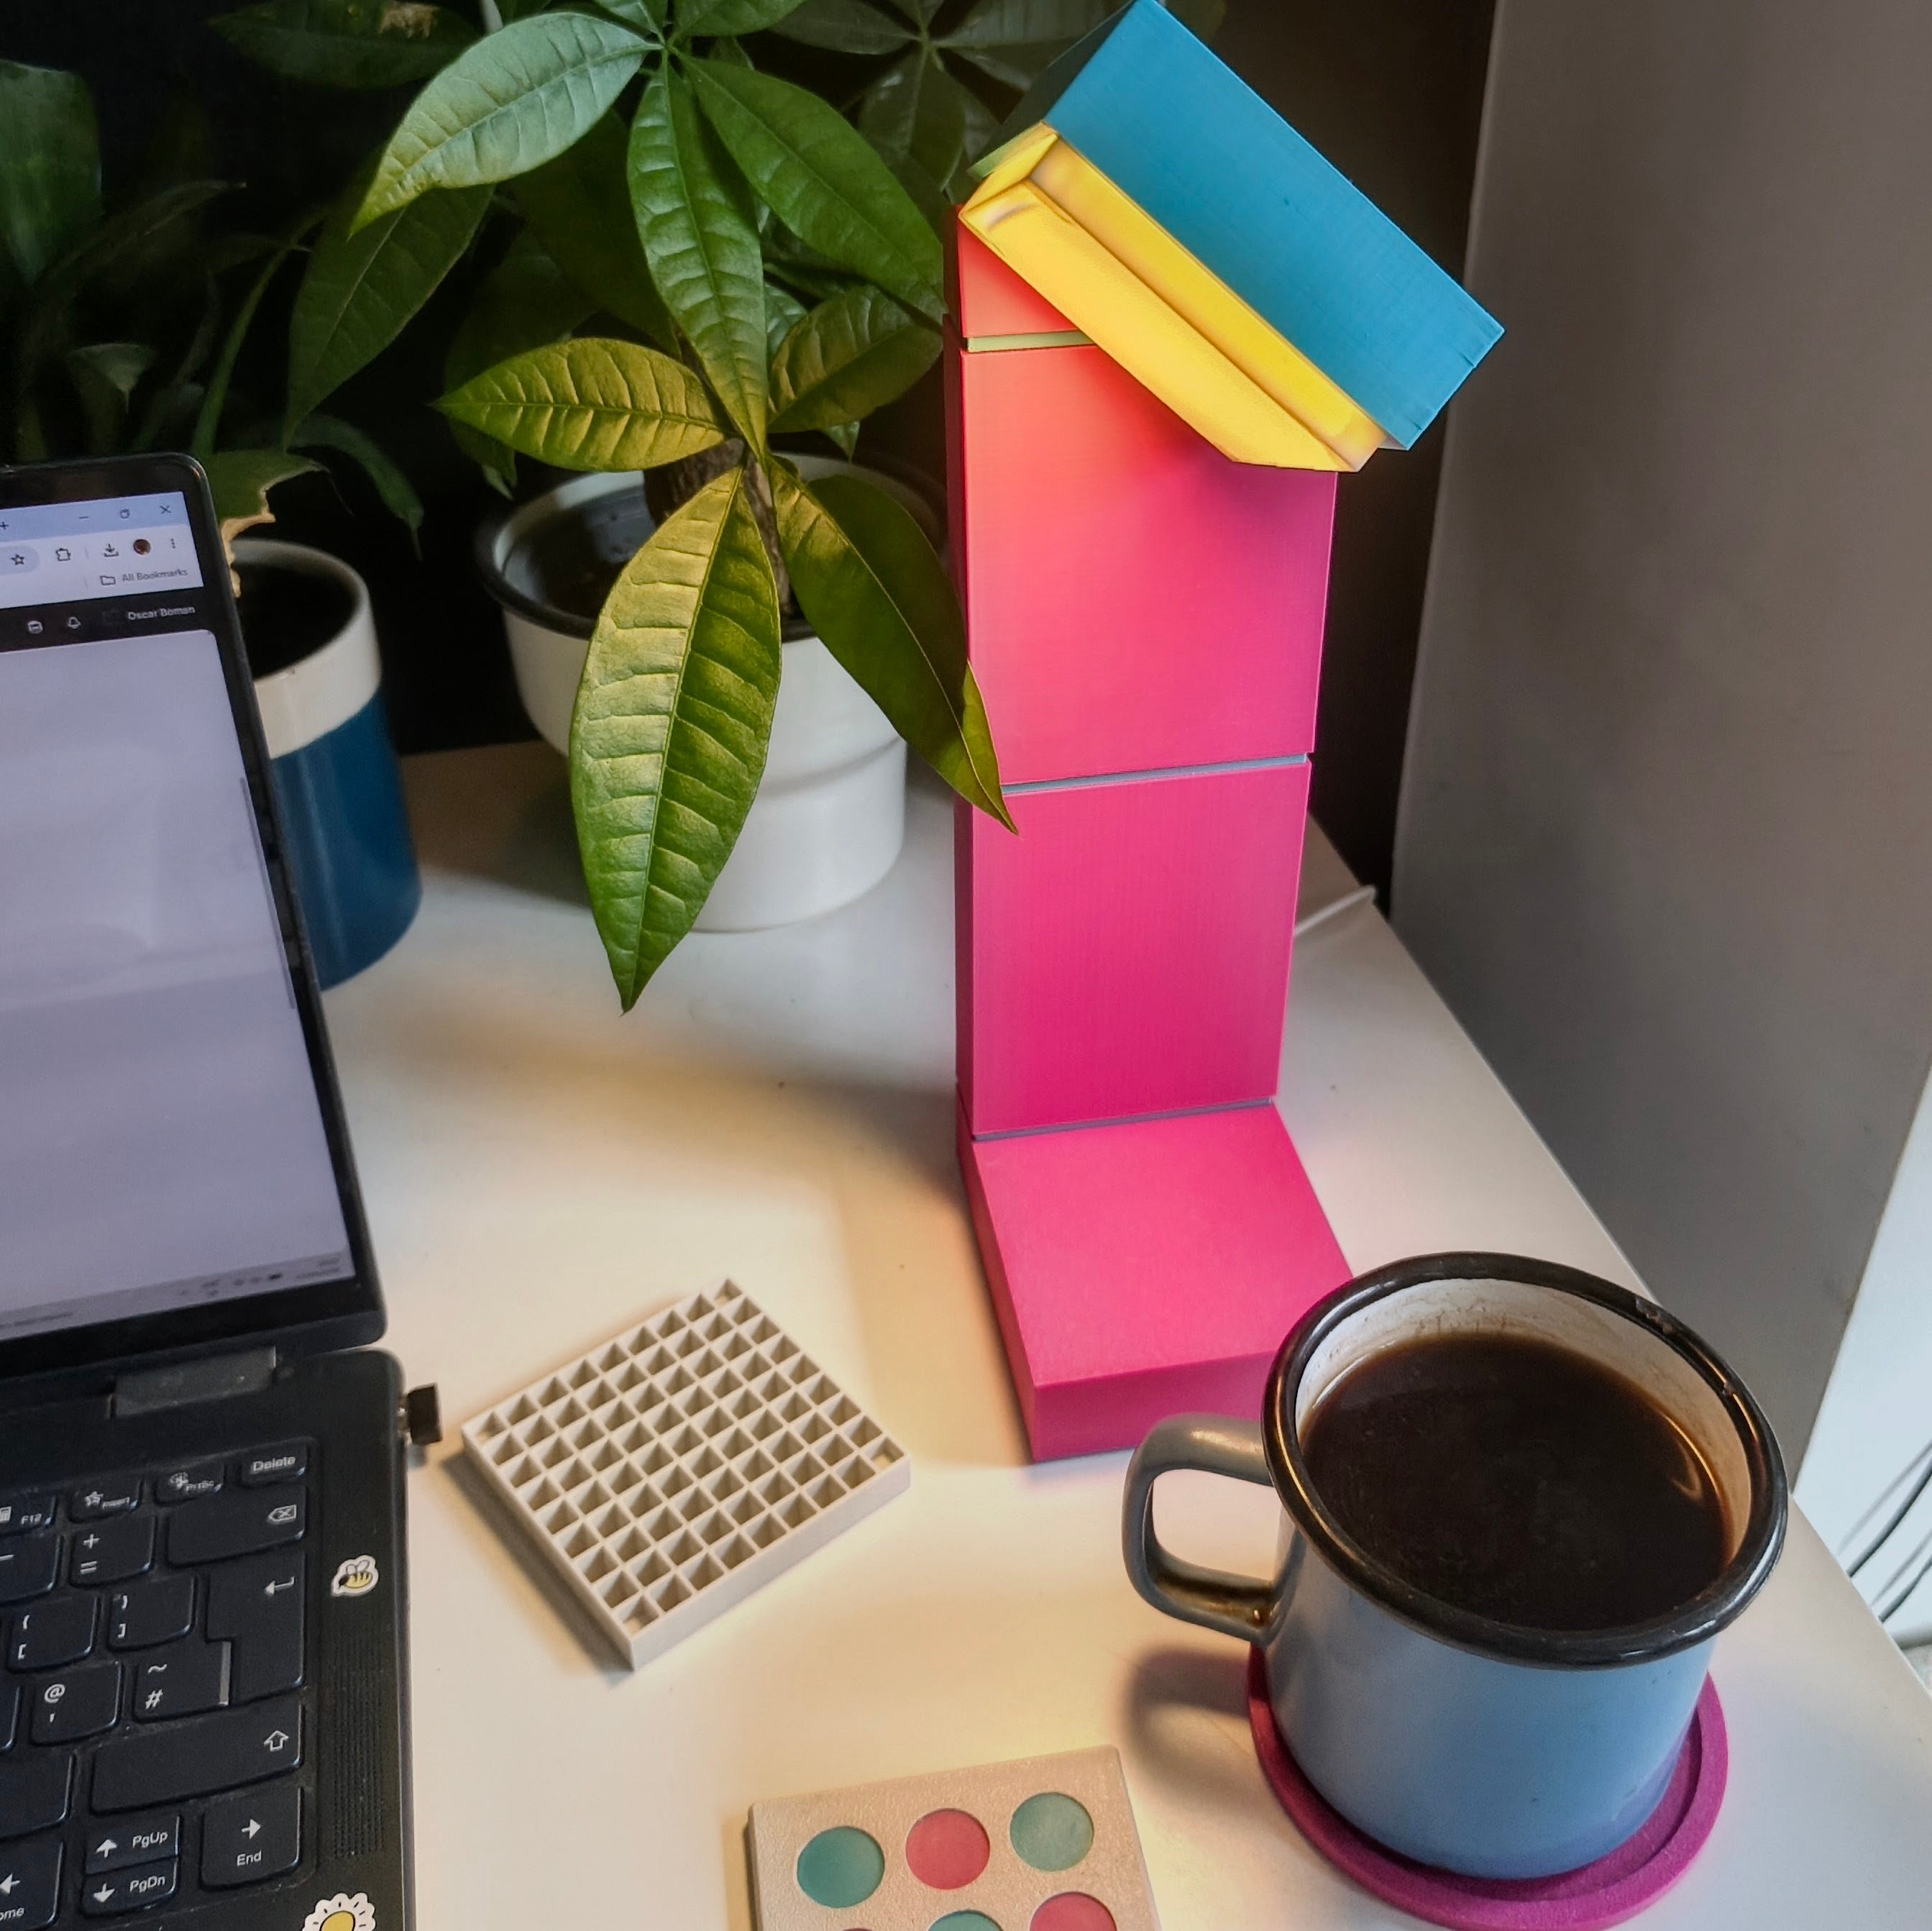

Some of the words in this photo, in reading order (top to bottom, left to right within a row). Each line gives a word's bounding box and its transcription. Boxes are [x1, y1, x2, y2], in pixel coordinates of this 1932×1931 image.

[122, 573, 134, 582] All
[137, 569, 188, 580] Bookmarks
[128, 611, 158, 620] Oscar
[44, 1684, 65, 1704] @
[145, 1689, 163, 1709] #
[132, 1831, 168, 1848] PgUp
[237, 1849, 262, 1866] End
[129, 1876, 166, 1892] PgDn
[0, 1907, 24, 1921] ome
